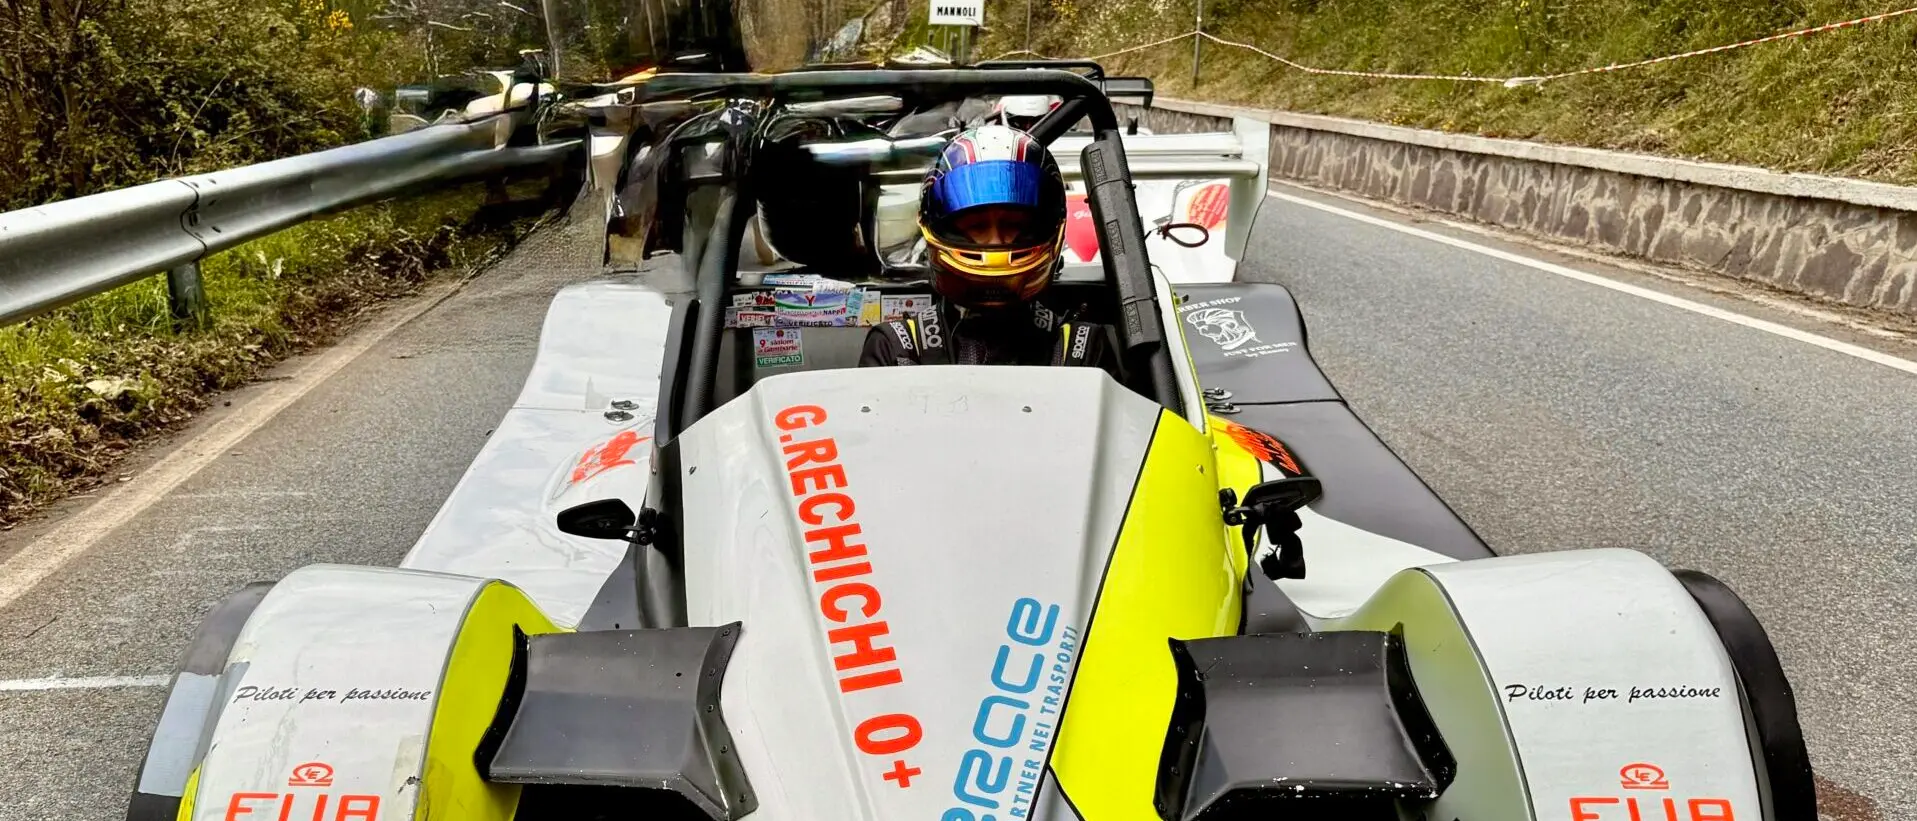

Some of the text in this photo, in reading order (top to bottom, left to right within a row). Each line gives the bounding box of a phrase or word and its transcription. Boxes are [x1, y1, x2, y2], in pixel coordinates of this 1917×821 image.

[937, 6, 976, 17] MANNOLI
[1209, 296, 1241, 306] SHOP
[890, 321, 914, 350] sparco
[1072, 325, 1090, 359] sparco
[759, 354, 801, 366] VERIFICATO
[775, 404, 903, 693] G.RECHICHI
[234, 685, 432, 704] Piloti per passione
[1029, 722, 1051, 752] NEI
[1040, 625, 1078, 714] TRASPORTI
[1504, 683, 1721, 704] Piloti per passione
